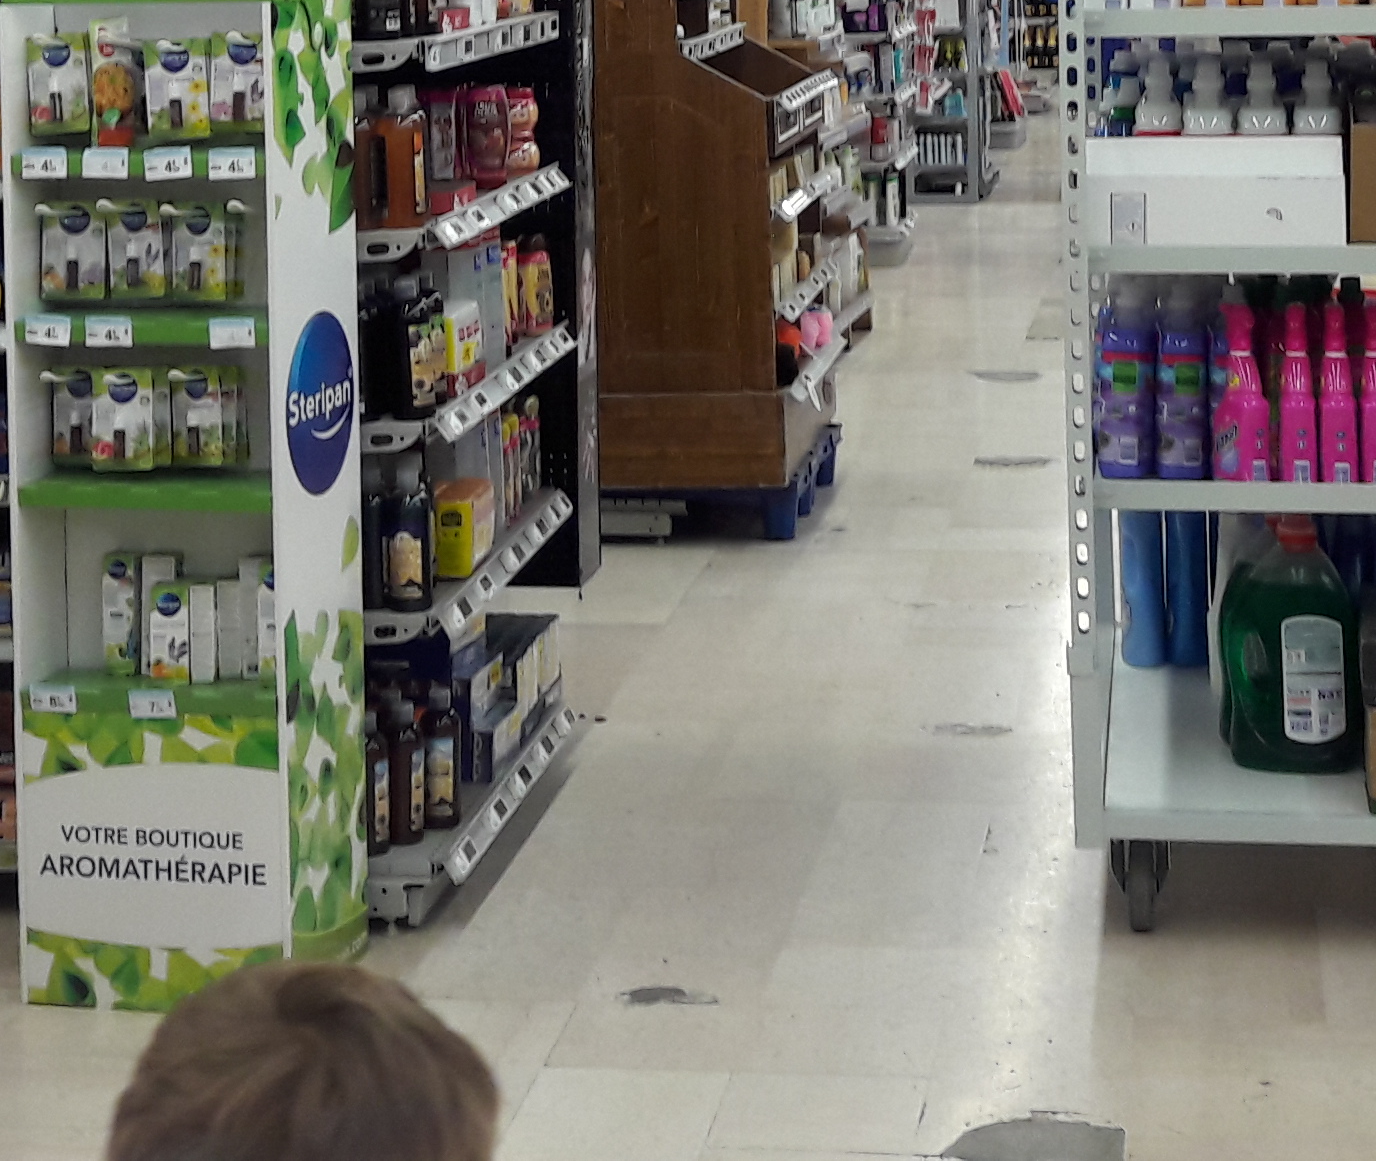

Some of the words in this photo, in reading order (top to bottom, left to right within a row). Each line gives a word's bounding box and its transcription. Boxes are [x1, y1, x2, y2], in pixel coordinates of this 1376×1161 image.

[287, 379, 352, 429] Steripan
[61, 824, 128, 847] VOTRE
[135, 829, 244, 851] BOUTIQUE
[39, 854, 268, 887] AROMATHÉRAPIE
